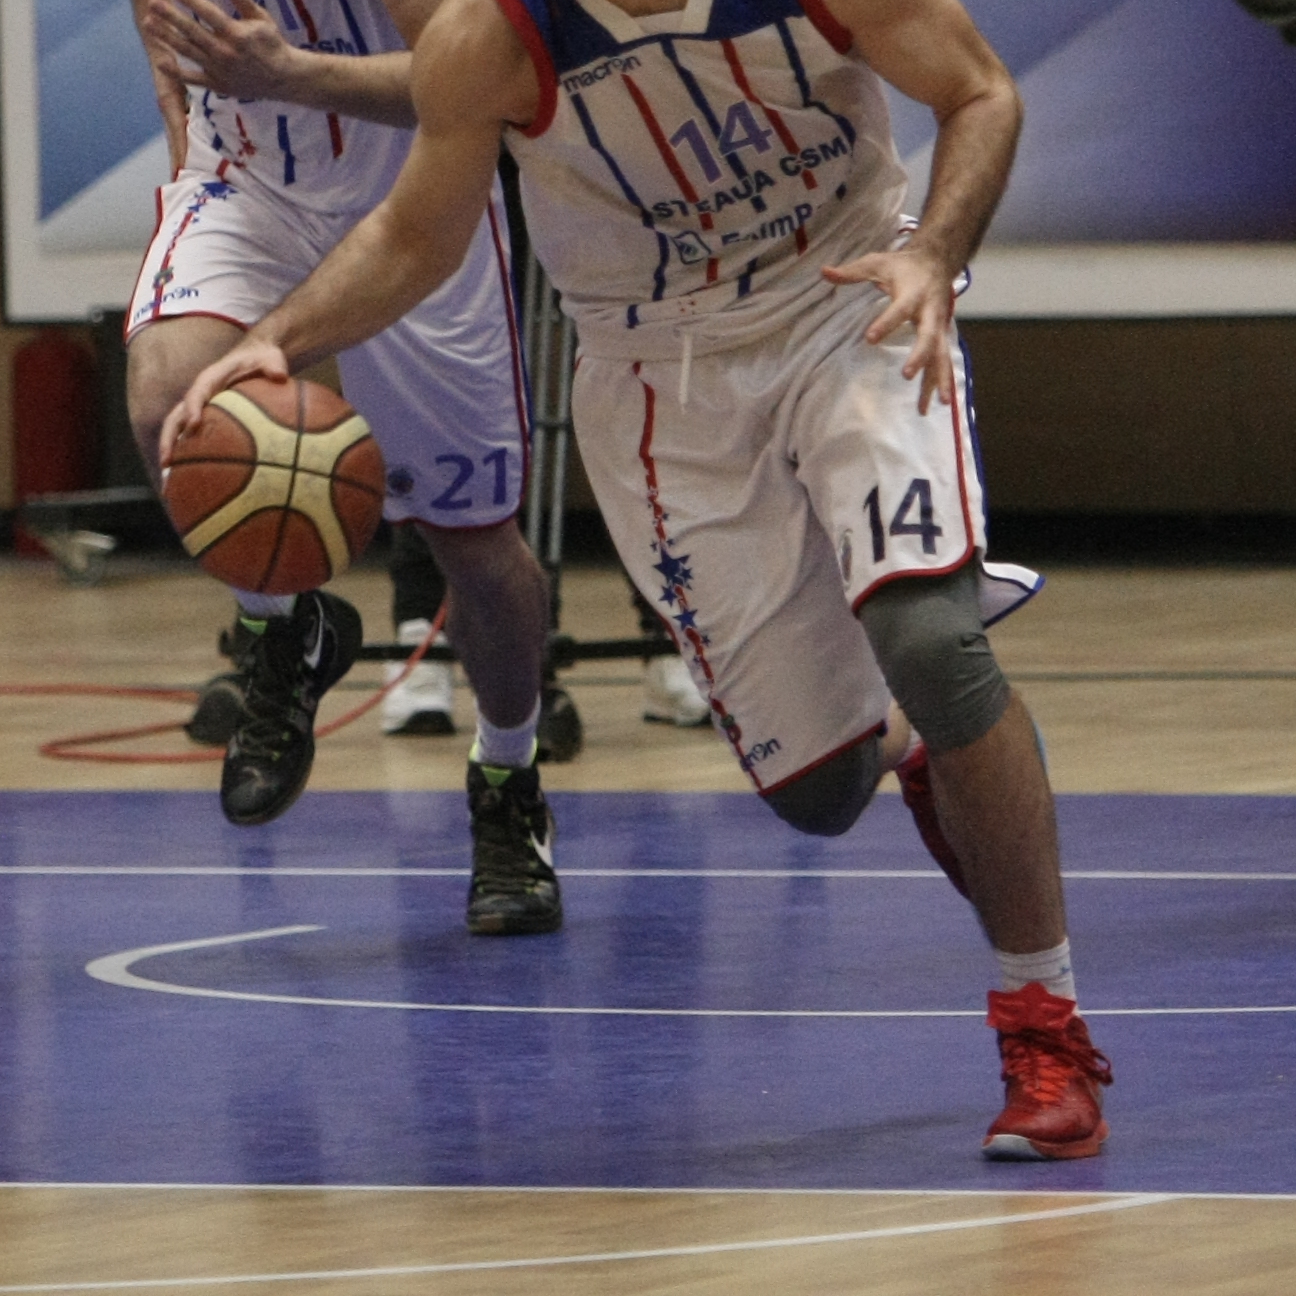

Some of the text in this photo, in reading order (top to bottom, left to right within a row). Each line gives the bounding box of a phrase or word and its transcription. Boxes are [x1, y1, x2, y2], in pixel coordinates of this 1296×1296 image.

[561, 53, 643, 94] macron
[653, 136, 849, 219] STEAUA CSM
[668, 100, 774, 185] 14
[429, 447, 509, 510] 21
[862, 477, 944, 564] 14
